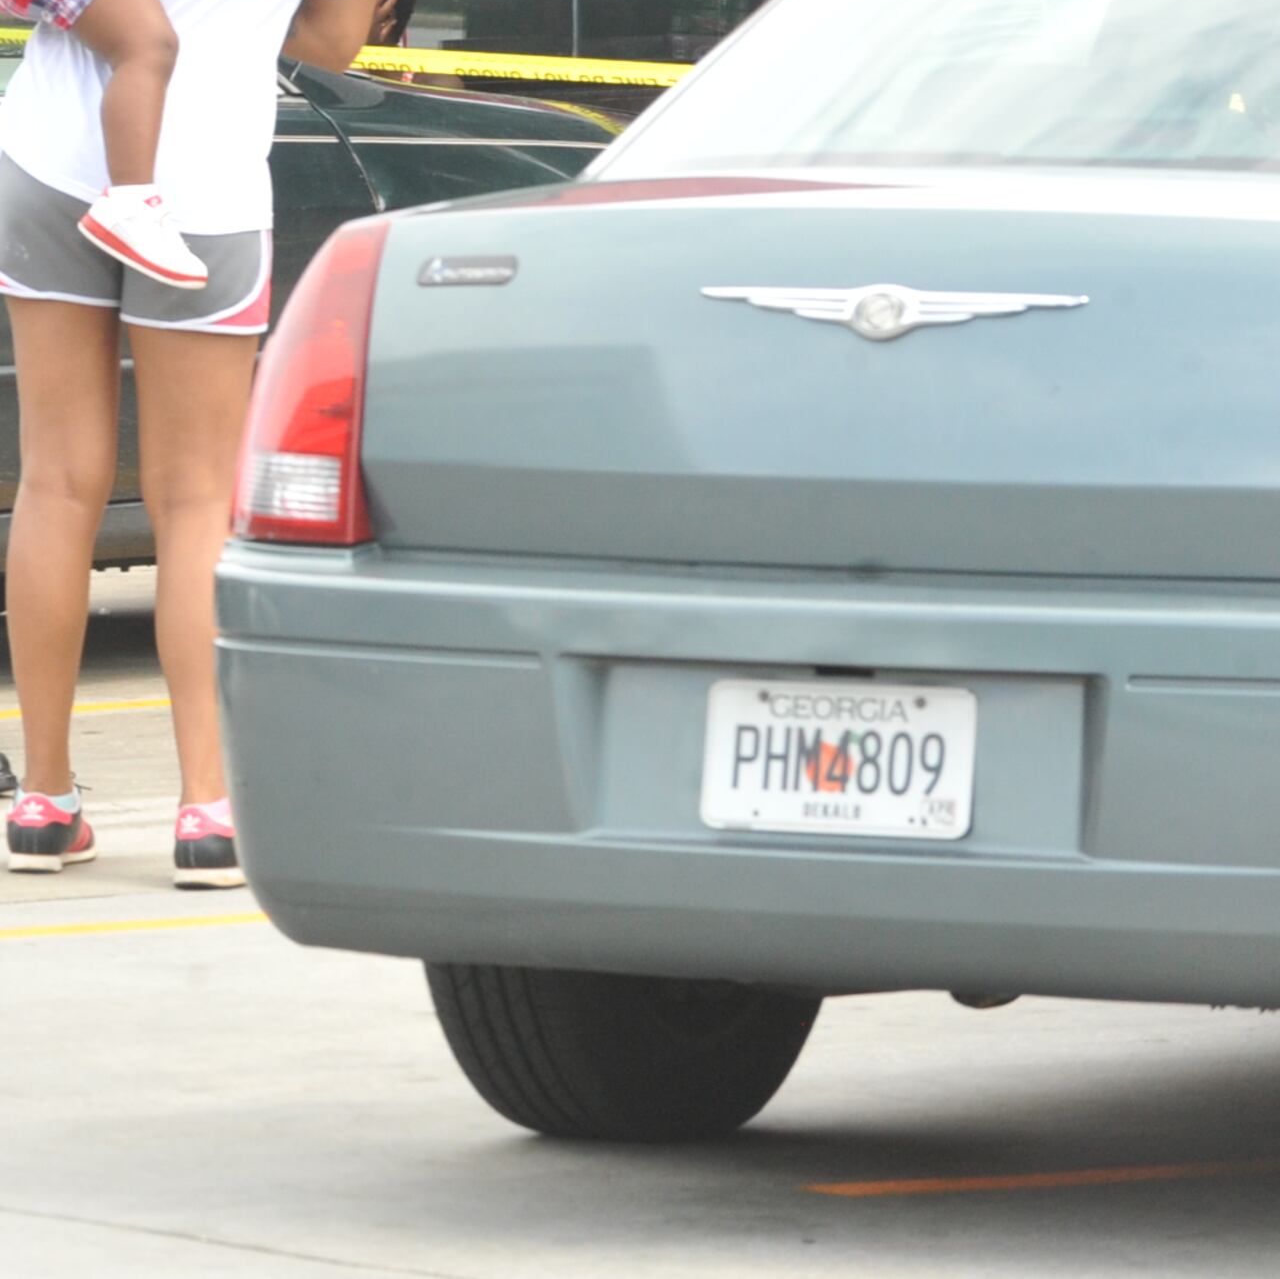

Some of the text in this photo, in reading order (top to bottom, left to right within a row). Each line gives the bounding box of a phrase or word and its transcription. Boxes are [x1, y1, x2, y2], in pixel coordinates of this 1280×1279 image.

[768, 693, 909, 723] GEORGIA
[731, 725, 946, 796] PHM4809
[803, 801, 862, 819] DEKALB
